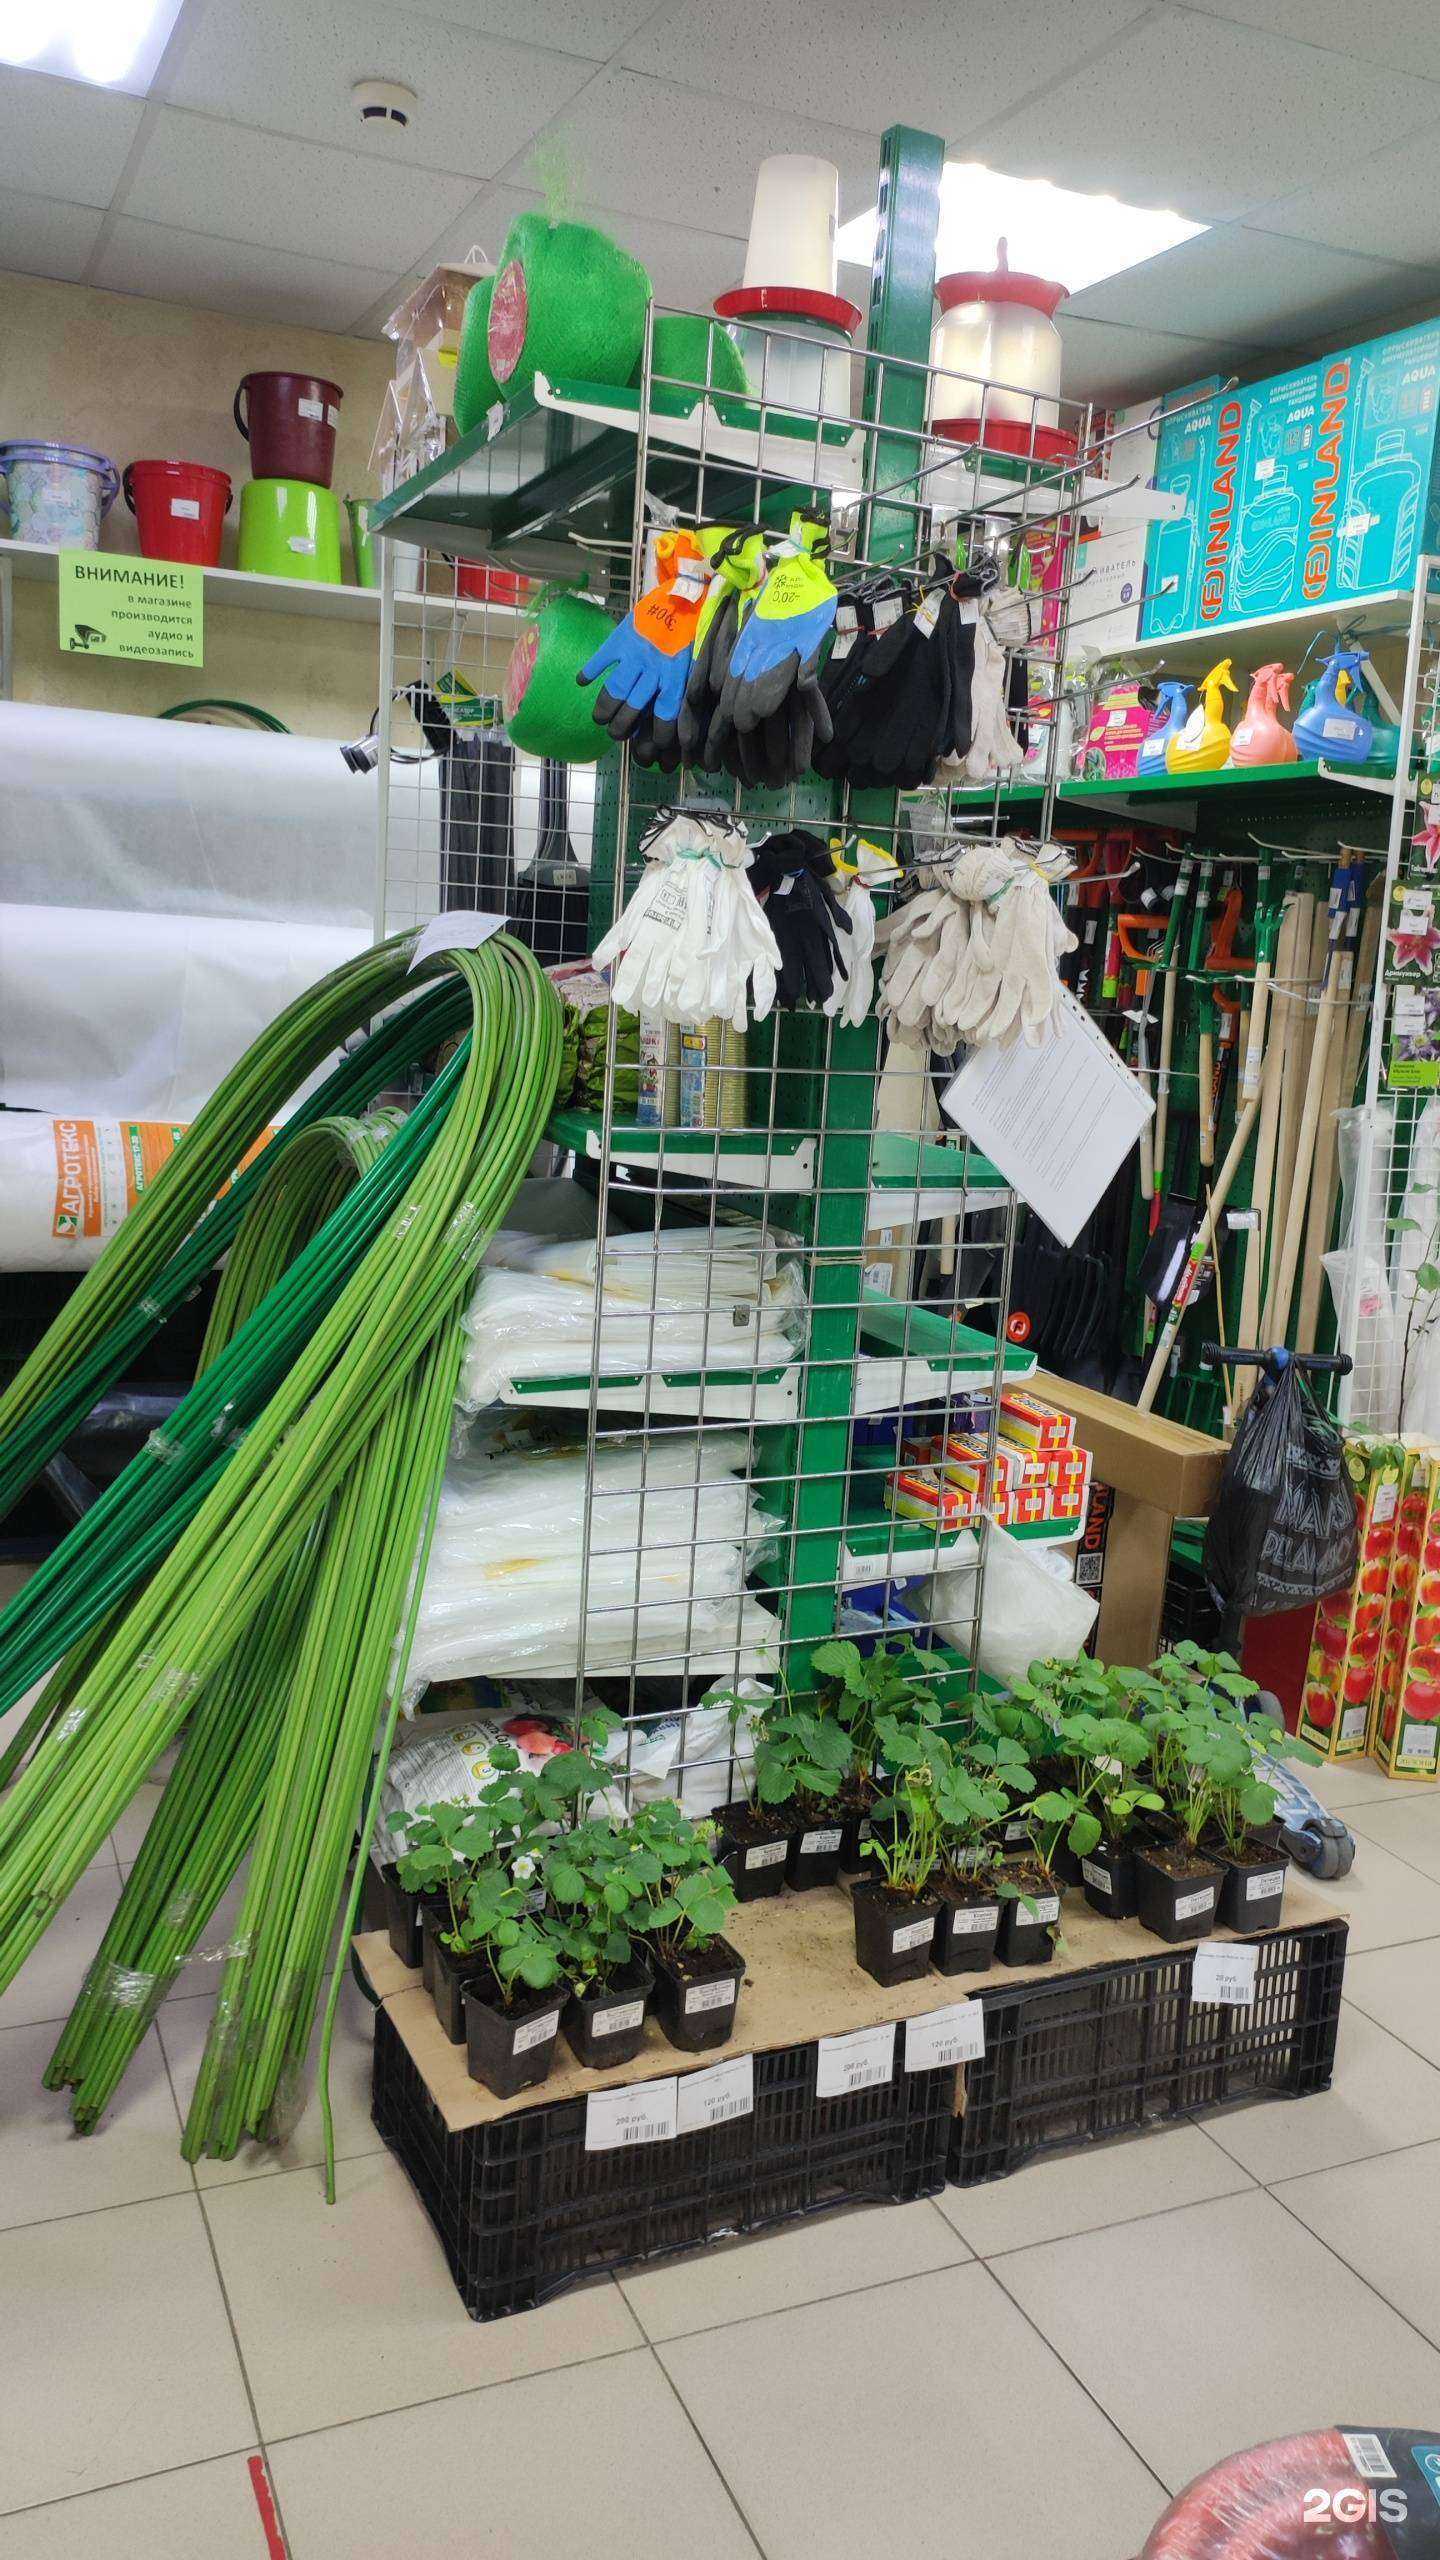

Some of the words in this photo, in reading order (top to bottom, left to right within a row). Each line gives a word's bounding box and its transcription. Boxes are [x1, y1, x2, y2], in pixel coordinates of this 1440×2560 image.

[1401, 365, 1436, 385] AQUA
[1287, 405, 1315, 424] AQUA
[1184, 415, 1212, 434] AQUA
[75, 565, 185, 589] ВНИМАНИЕ!
[127, 595, 134, 604] в
[137, 597, 192, 608] магазине
[111, 611, 193, 625] производится
[147, 630, 183, 642] аудио
[186, 634, 194, 642] и
[119, 645, 194, 659] видеозапись
[60, 1122, 82, 1214] АГРОТЕКС
